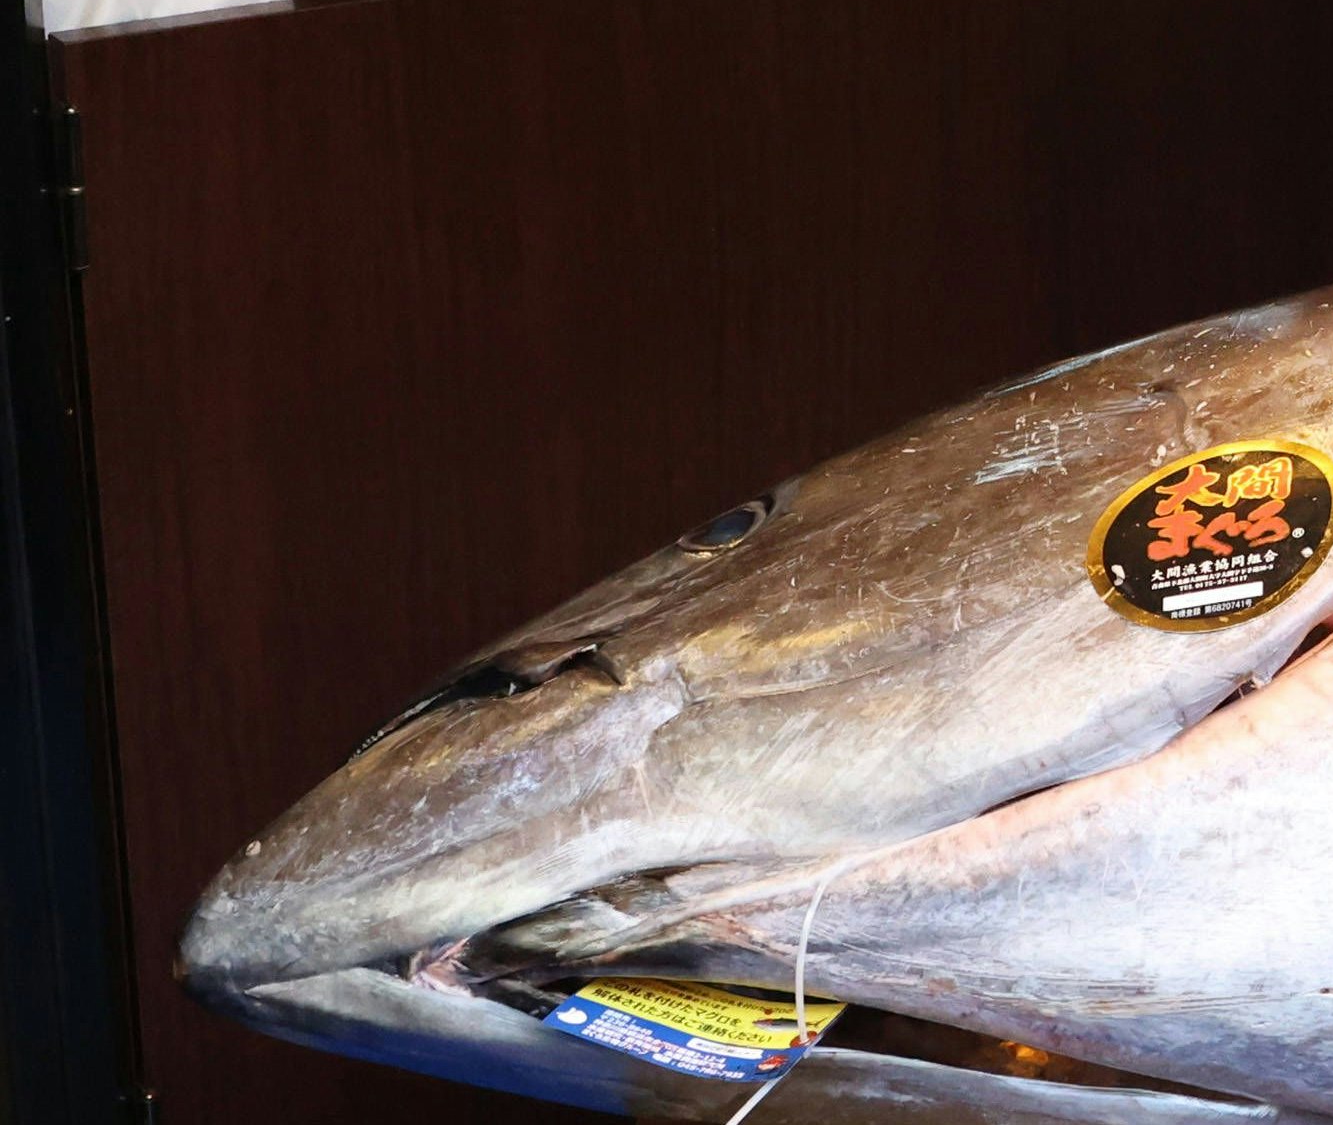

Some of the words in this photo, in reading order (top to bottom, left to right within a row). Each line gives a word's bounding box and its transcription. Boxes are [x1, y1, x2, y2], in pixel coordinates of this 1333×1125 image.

[1154, 456, 1294, 517] 大間
[1146, 499, 1291, 562] まぐろ
[1151, 549, 1279, 582] 大間漁業協同組合
